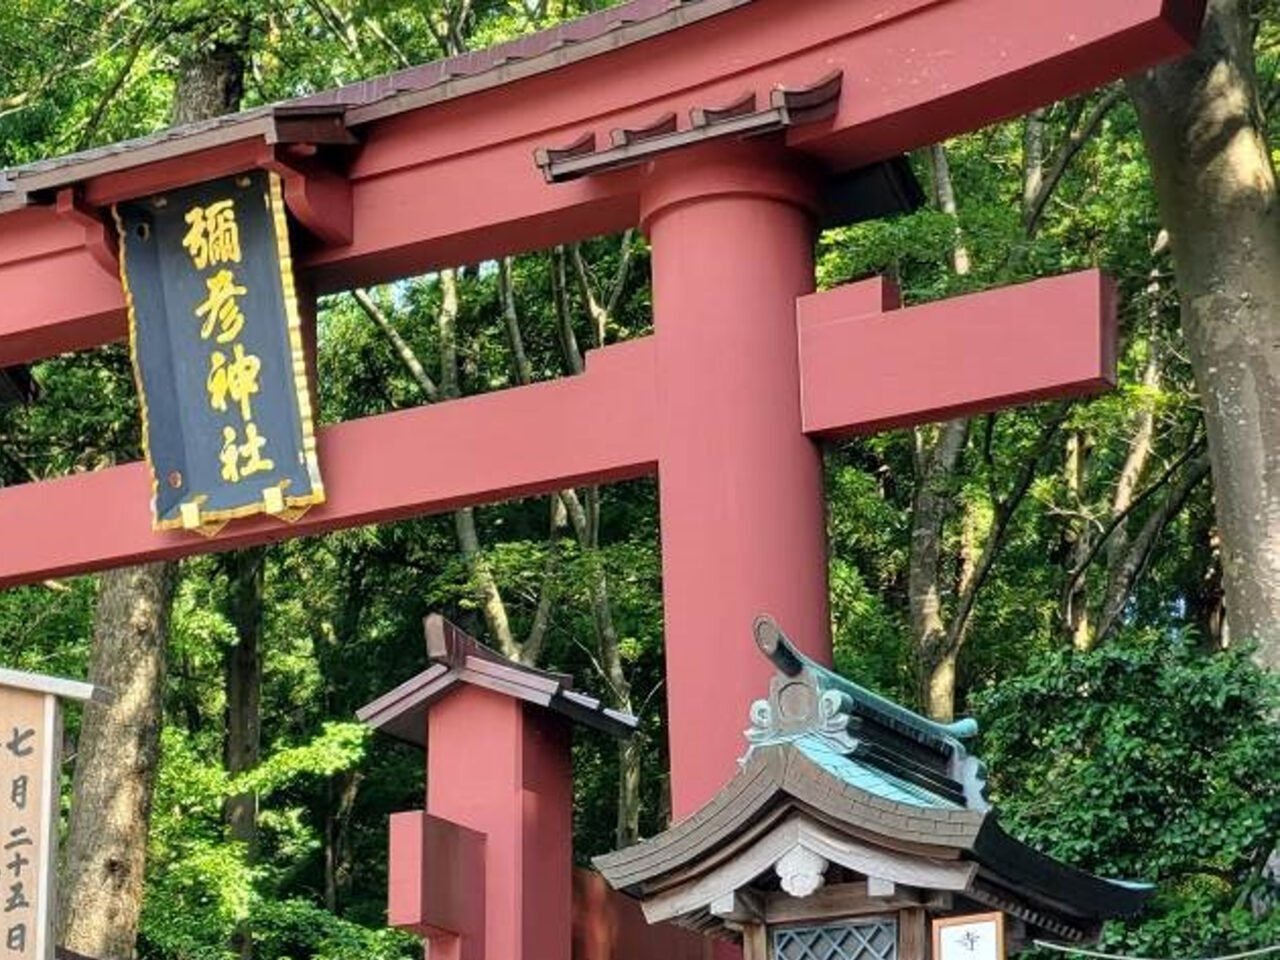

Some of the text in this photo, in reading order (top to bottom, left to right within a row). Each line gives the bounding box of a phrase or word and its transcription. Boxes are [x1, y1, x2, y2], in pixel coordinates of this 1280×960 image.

[182, 198, 275, 482] 彌彦神社
[4, 727, 35, 953] 七月二十五日
